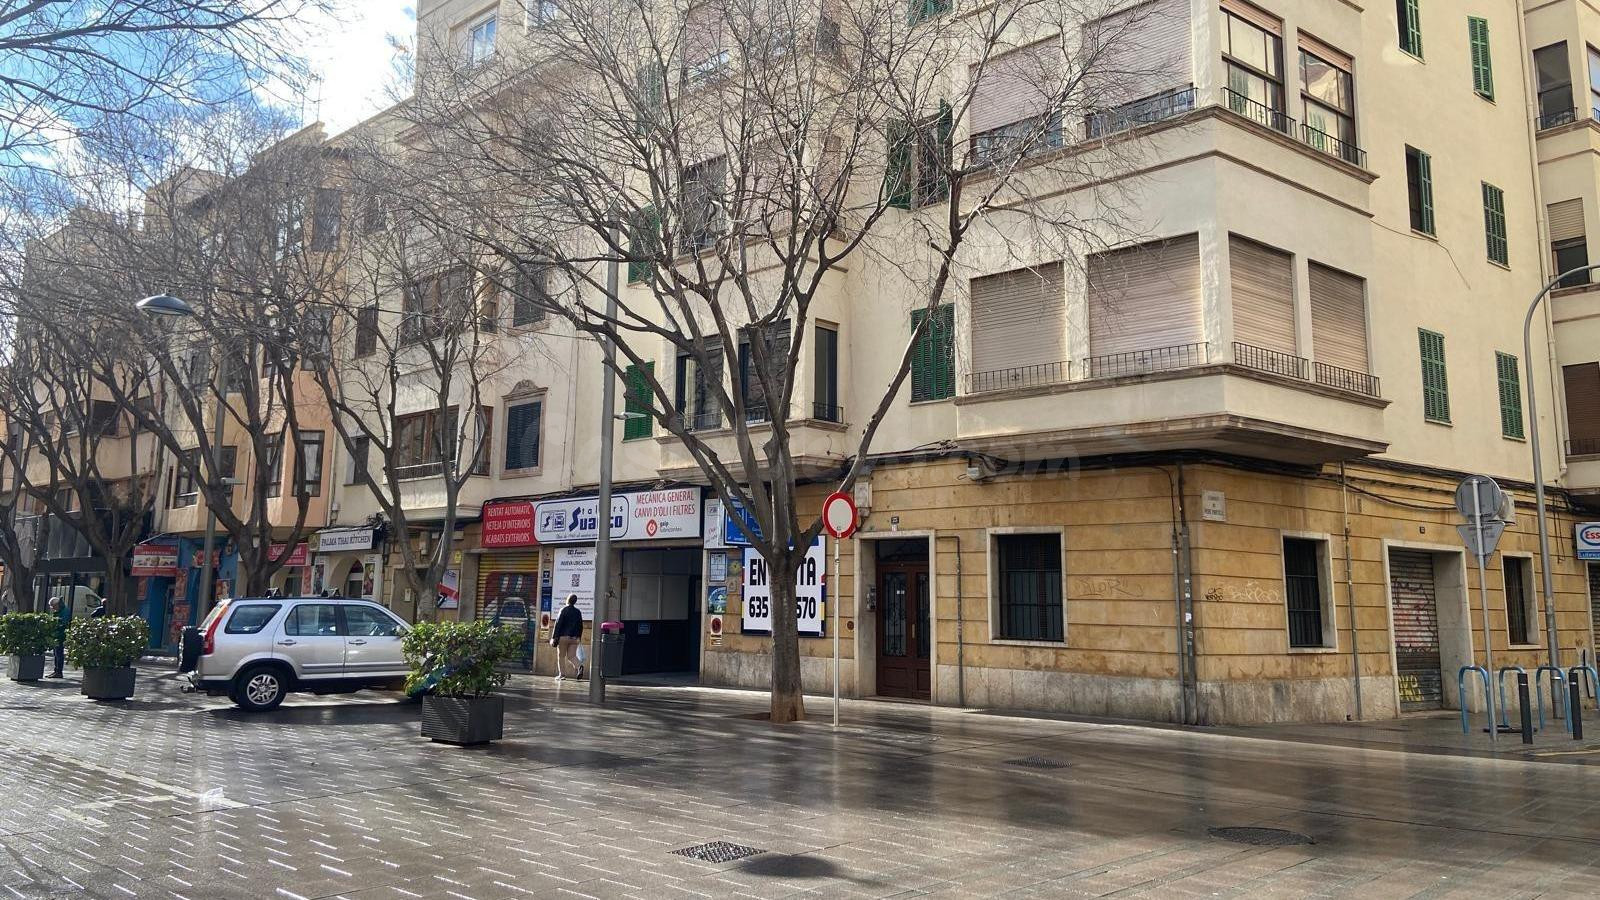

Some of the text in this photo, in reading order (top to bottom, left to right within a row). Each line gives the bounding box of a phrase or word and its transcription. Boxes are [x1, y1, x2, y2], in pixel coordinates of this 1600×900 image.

[667, 490, 694, 502] GENERAL
[488, 507, 504, 517] RENTAT
[634, 507, 651, 518] CANVI
[653, 506, 669, 517] D'OLI
[673, 504, 695, 515] FILTRES
[486, 518, 531, 530] NETEJA D'INTERIORS
[321, 535, 371, 547] PALMA THAI KITCHEN
[485, 532, 530, 544] ACABATS EXTERIORS
[750, 558, 766, 586] EN
[749, 596, 768, 618] 635
